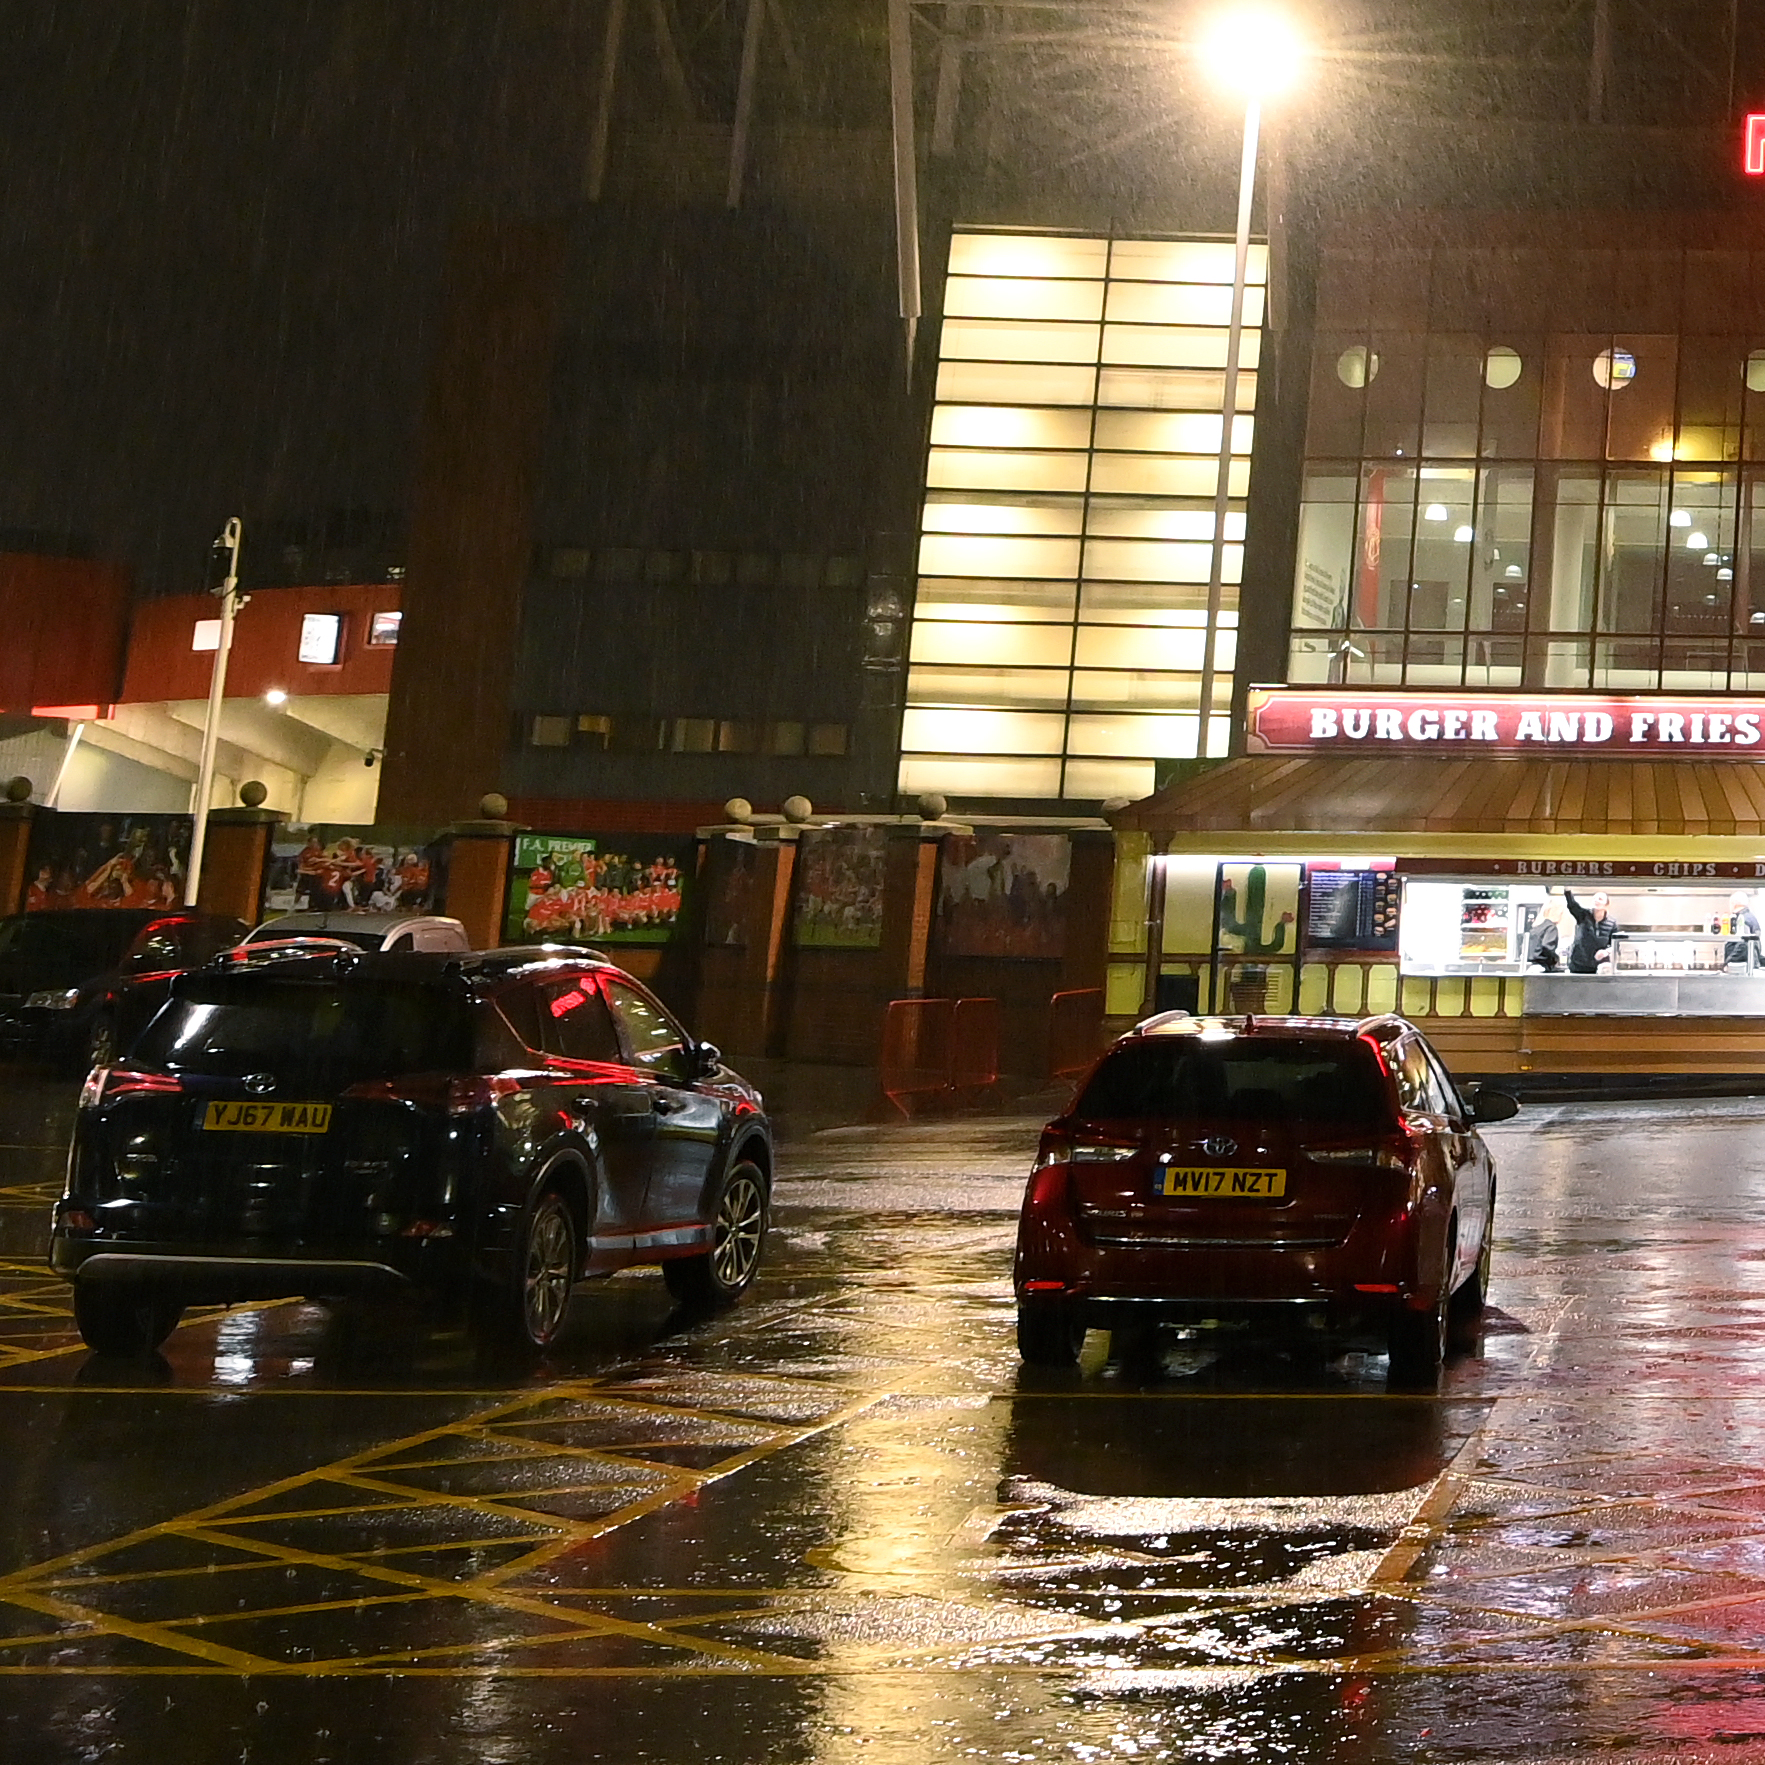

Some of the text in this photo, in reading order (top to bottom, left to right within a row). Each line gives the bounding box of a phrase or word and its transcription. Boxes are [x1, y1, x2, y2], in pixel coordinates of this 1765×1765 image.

[1309, 707, 1500, 742] BURGER
[1515, 710, 1614, 743] AND
[1629, 712, 1762, 745] FRIES
[1516, 861, 1614, 876] BURGERS
[1653, 862, 1717, 877] CHIPS
[213, 1104, 328, 1128] YJ67 WAU
[1173, 1171, 1278, 1193] MV17 NZT
